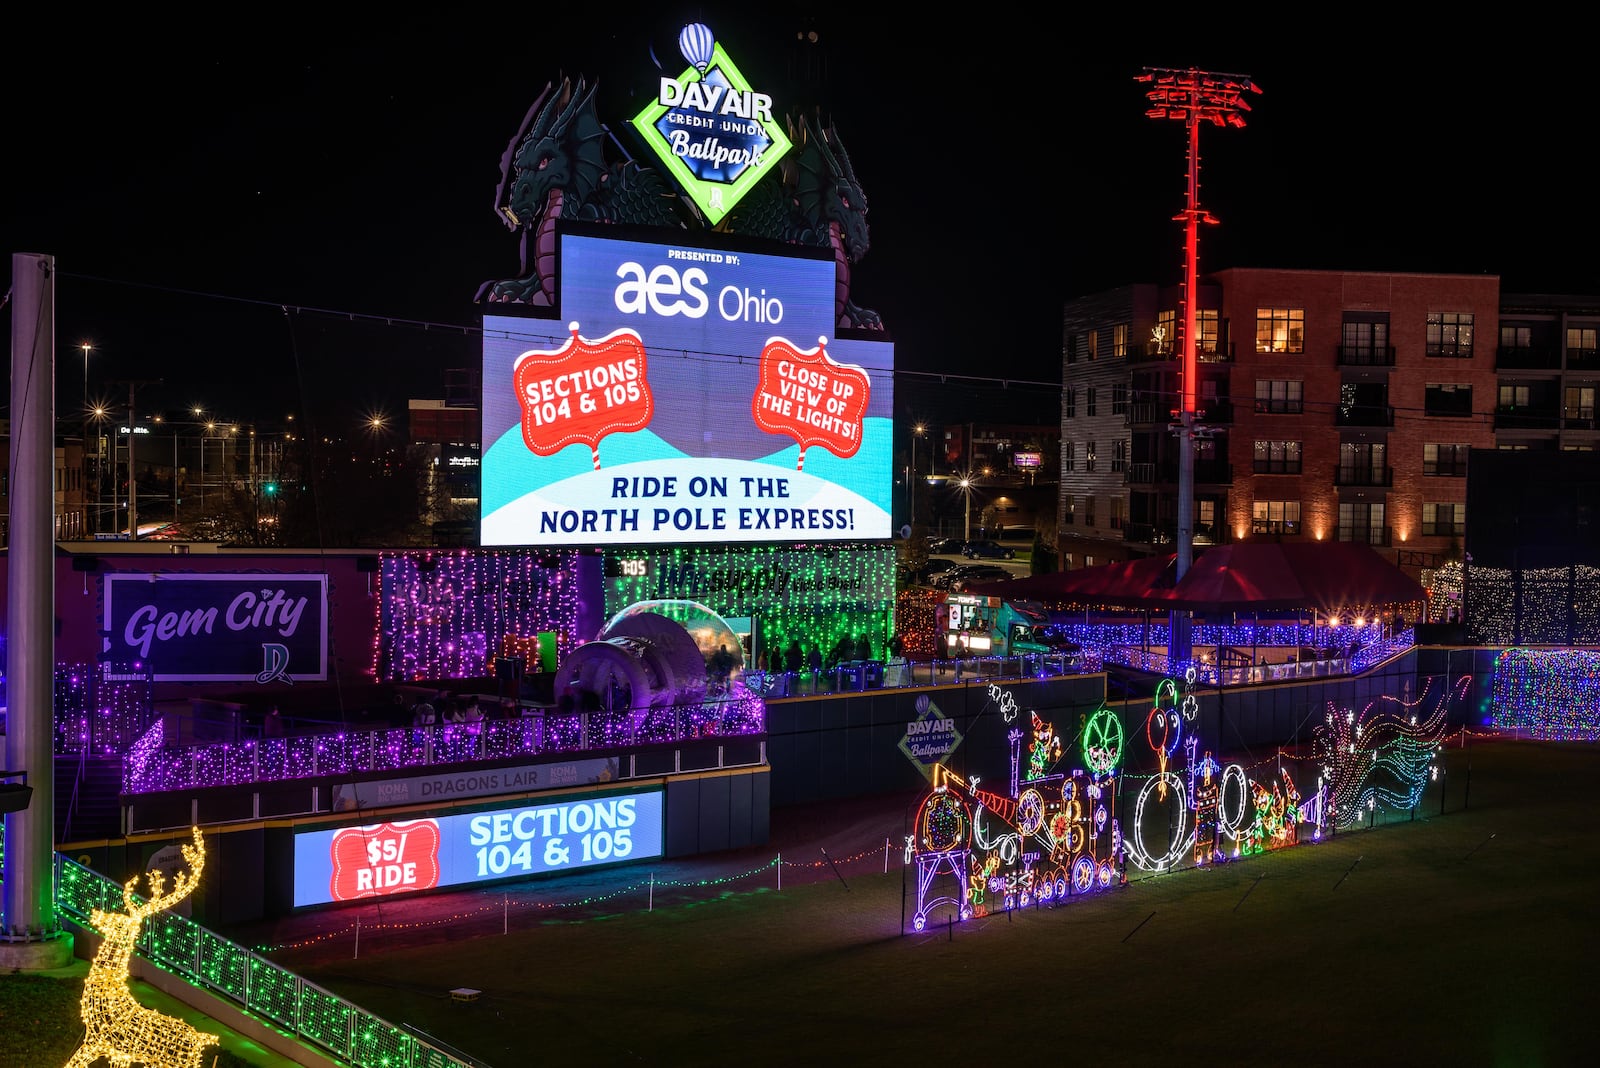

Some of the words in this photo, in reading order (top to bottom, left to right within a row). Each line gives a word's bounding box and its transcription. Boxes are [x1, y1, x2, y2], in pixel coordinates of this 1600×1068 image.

[660, 76, 722, 112] DAY
[720, 89, 772, 122] AIR
[667, 112, 714, 129] CREDIT
[722, 121, 766, 137] UNION
[669, 130, 765, 169] Ballpark
[668, 249, 722, 262] PRESENTED
[726, 256, 740, 266] BY:
[614, 262, 709, 318] aes
[718, 285, 783, 325] Ohio
[526, 358, 638, 405] SECTIONS
[778, 360, 828, 391] CLOSE
[833, 380, 853, 399] UP
[533, 398, 571, 426] 104
[580, 393, 597, 413] &
[604, 381, 640, 408] 105
[780, 380, 821, 407] VIEW
[826, 398, 847, 416] OF
[762, 392, 793, 416] THE
[796, 405, 857, 440] LIGHTS!
[611, 477, 677, 498] RIDE
[688, 477, 728, 497] ON
[739, 478, 790, 497] THE
[540, 509, 638, 533] NORTH
[653, 508, 726, 531] POLE
[738, 508, 855, 530] EXPRESS!
[620, 560, 646, 576] 7:05
[124, 605, 218, 658] Gem
[226, 588, 308, 638] City
[907, 720, 934, 736] DAY
[932, 718, 954, 733] AIR
[911, 742, 950, 757] Ballpark
[421, 775, 499, 796] DRAGONS
[504, 771, 538, 787] LAIR
[550, 766, 577, 778] KONA
[377, 784, 408, 796] KONA
[470, 798, 636, 846] SECTIONS
[367, 834, 406, 867] $5/
[476, 844, 532, 877] 104
[544, 838, 570, 865] &
[581, 829, 633, 863] 105
[356, 862, 417, 891] RIDE
